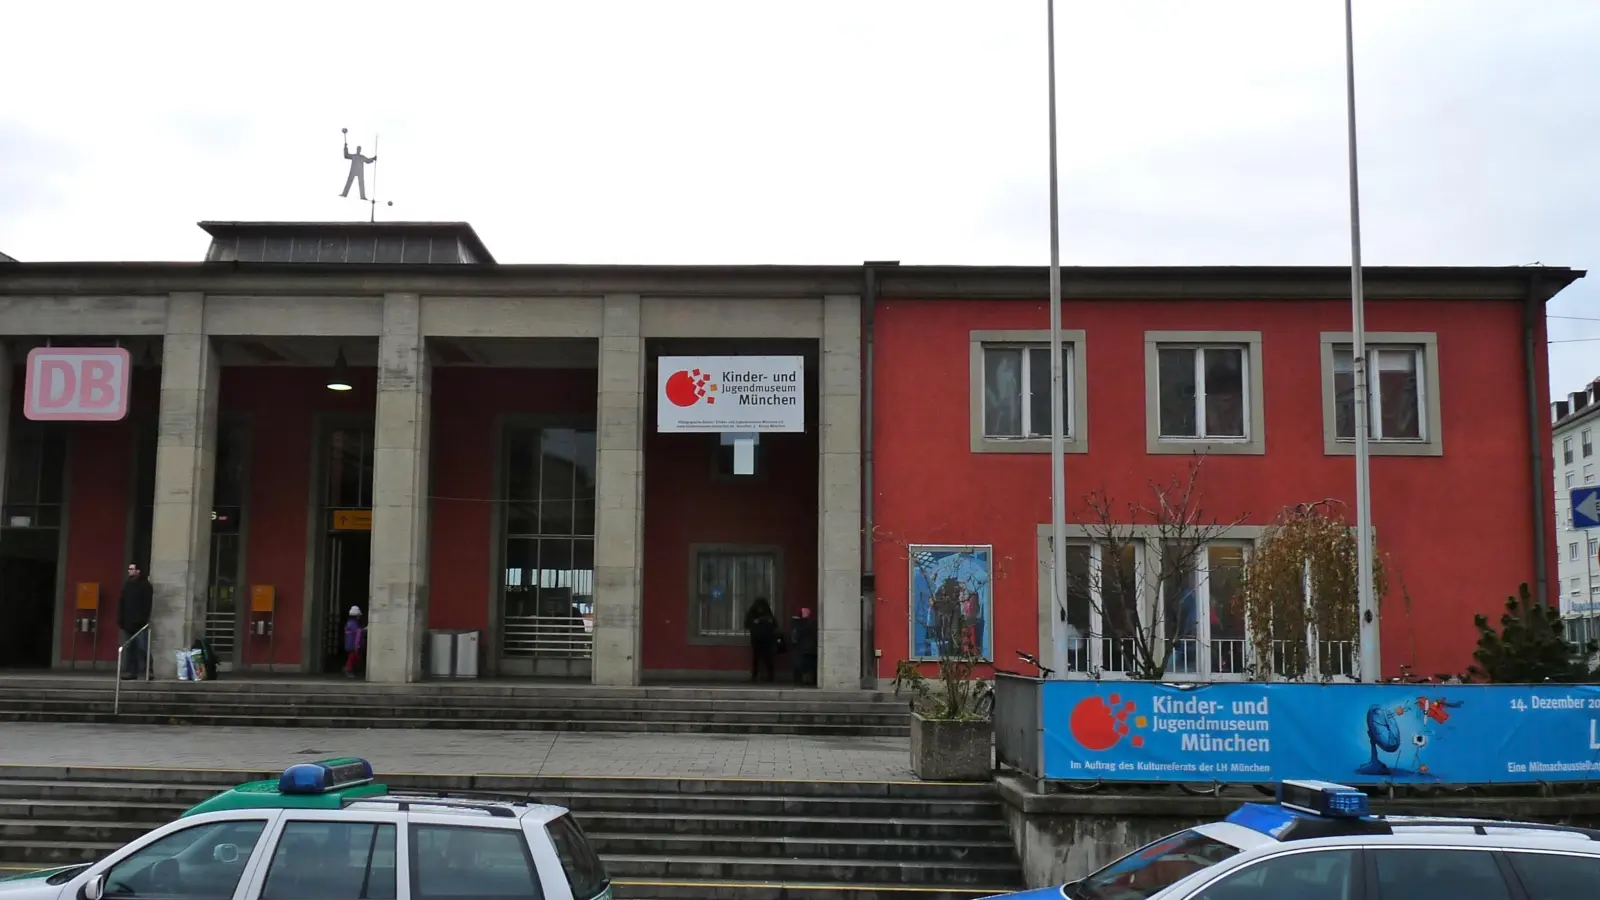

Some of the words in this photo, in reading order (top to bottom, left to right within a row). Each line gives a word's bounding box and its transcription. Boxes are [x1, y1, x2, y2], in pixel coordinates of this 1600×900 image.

[39, 360, 115, 408] DB
[722, 371, 767, 382] Kinder-
[773, 371, 796, 382] und
[722, 384, 796, 394] Jugendmuseum
[739, 394, 796, 405] München
[1153, 696, 1224, 714] Kinder-
[1232, 696, 1268, 715] und
[1511, 698, 1528, 712] 14.
[1532, 695, 1585, 709] Dezember
[1153, 716, 1269, 733] Jugendmuseum
[1181, 733, 1270, 752] München
[1070, 760, 1082, 769] Im
[1084, 760, 1116, 772] Auftrag
[1118, 761, 1135, 770] des
[1137, 761, 1197, 772] Kulturreferats
[1199, 762, 1214, 772] der
[1216, 763, 1228, 772] LH
[1230, 763, 1270, 773] München
[1508, 761, 1527, 772] Eine
